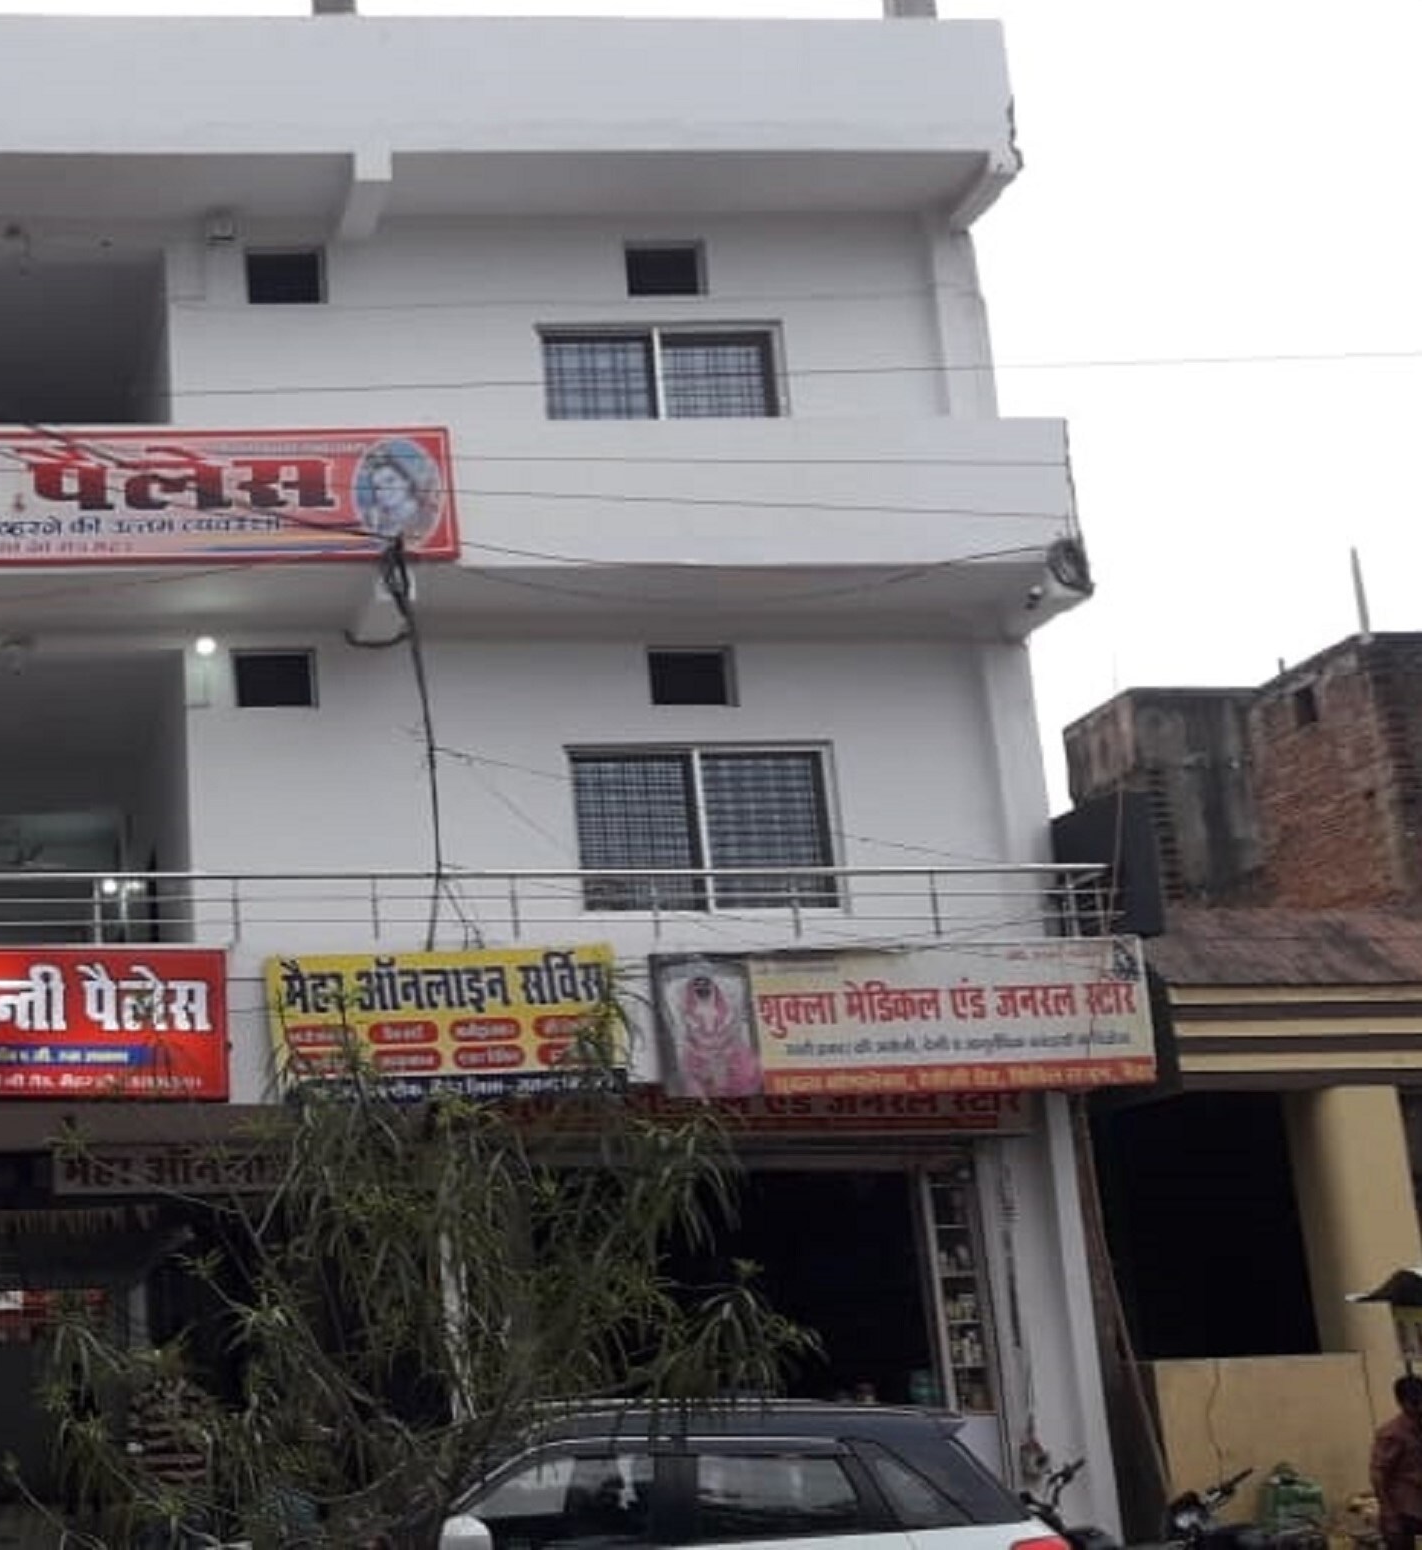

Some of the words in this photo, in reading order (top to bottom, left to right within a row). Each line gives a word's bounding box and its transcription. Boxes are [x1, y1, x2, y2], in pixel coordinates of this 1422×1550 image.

[17, 443, 336, 511] पैलेस
[69, 516, 102, 535] की
[76, 962, 213, 1032] पैलेस
[281, 957, 345, 1014] मैहर
[354, 955, 510, 1013] ऑनलाइन
[517, 950, 606, 1006] सर्विस
[758, 992, 836, 1039] शुक्ला
[844, 980, 941, 1025] मेडिकल
[950, 977, 986, 1020] एंड
[994, 984, 1076, 1018] जनरल
[1083, 975, 1138, 1016] स्टोर
